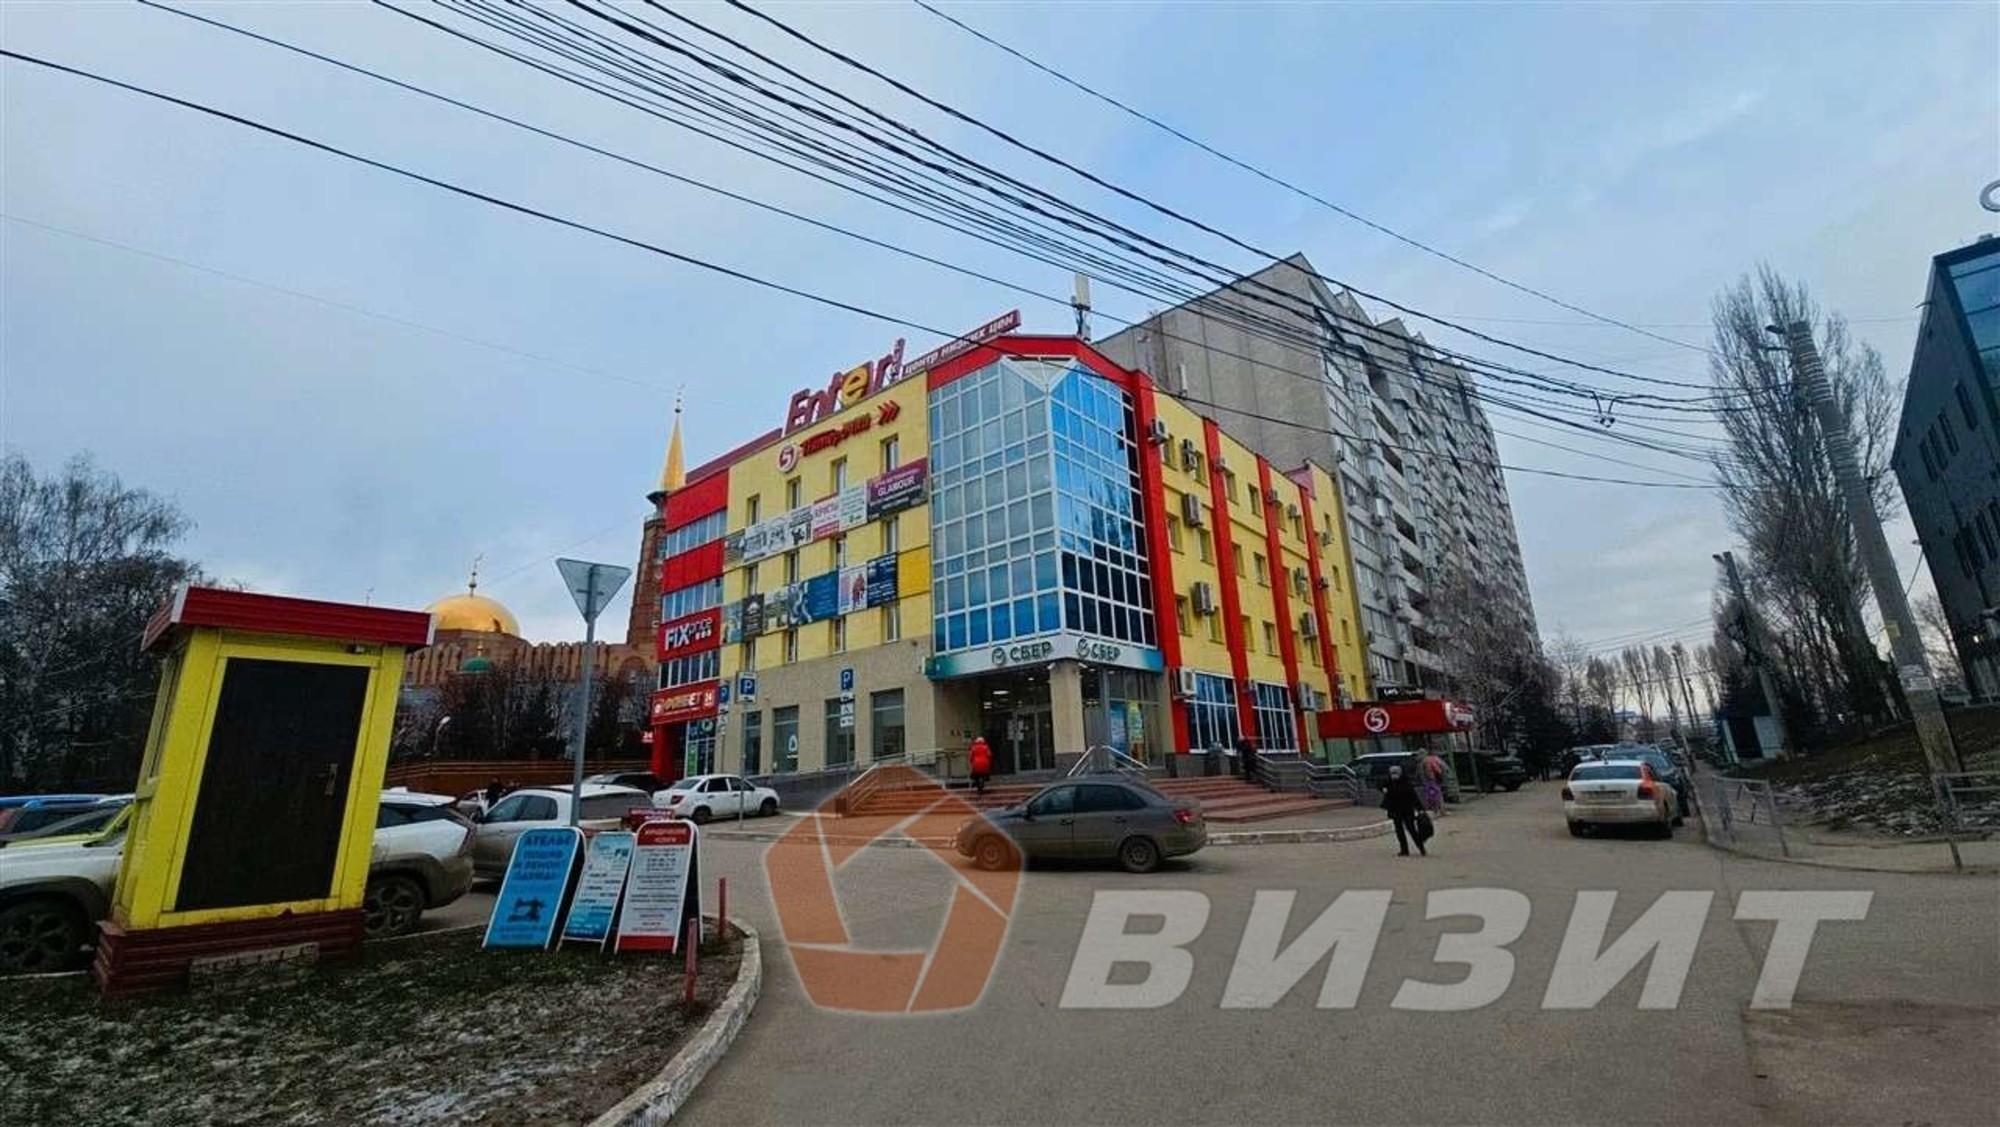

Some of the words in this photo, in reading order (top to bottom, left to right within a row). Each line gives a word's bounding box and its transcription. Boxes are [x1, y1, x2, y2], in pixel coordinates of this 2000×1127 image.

[877, 475, 915, 497] GLAMOUR
[664, 623, 690, 652] FIX
[1010, 641, 1053, 662] СБЕР
[1089, 642, 1121, 662] СБЕР
